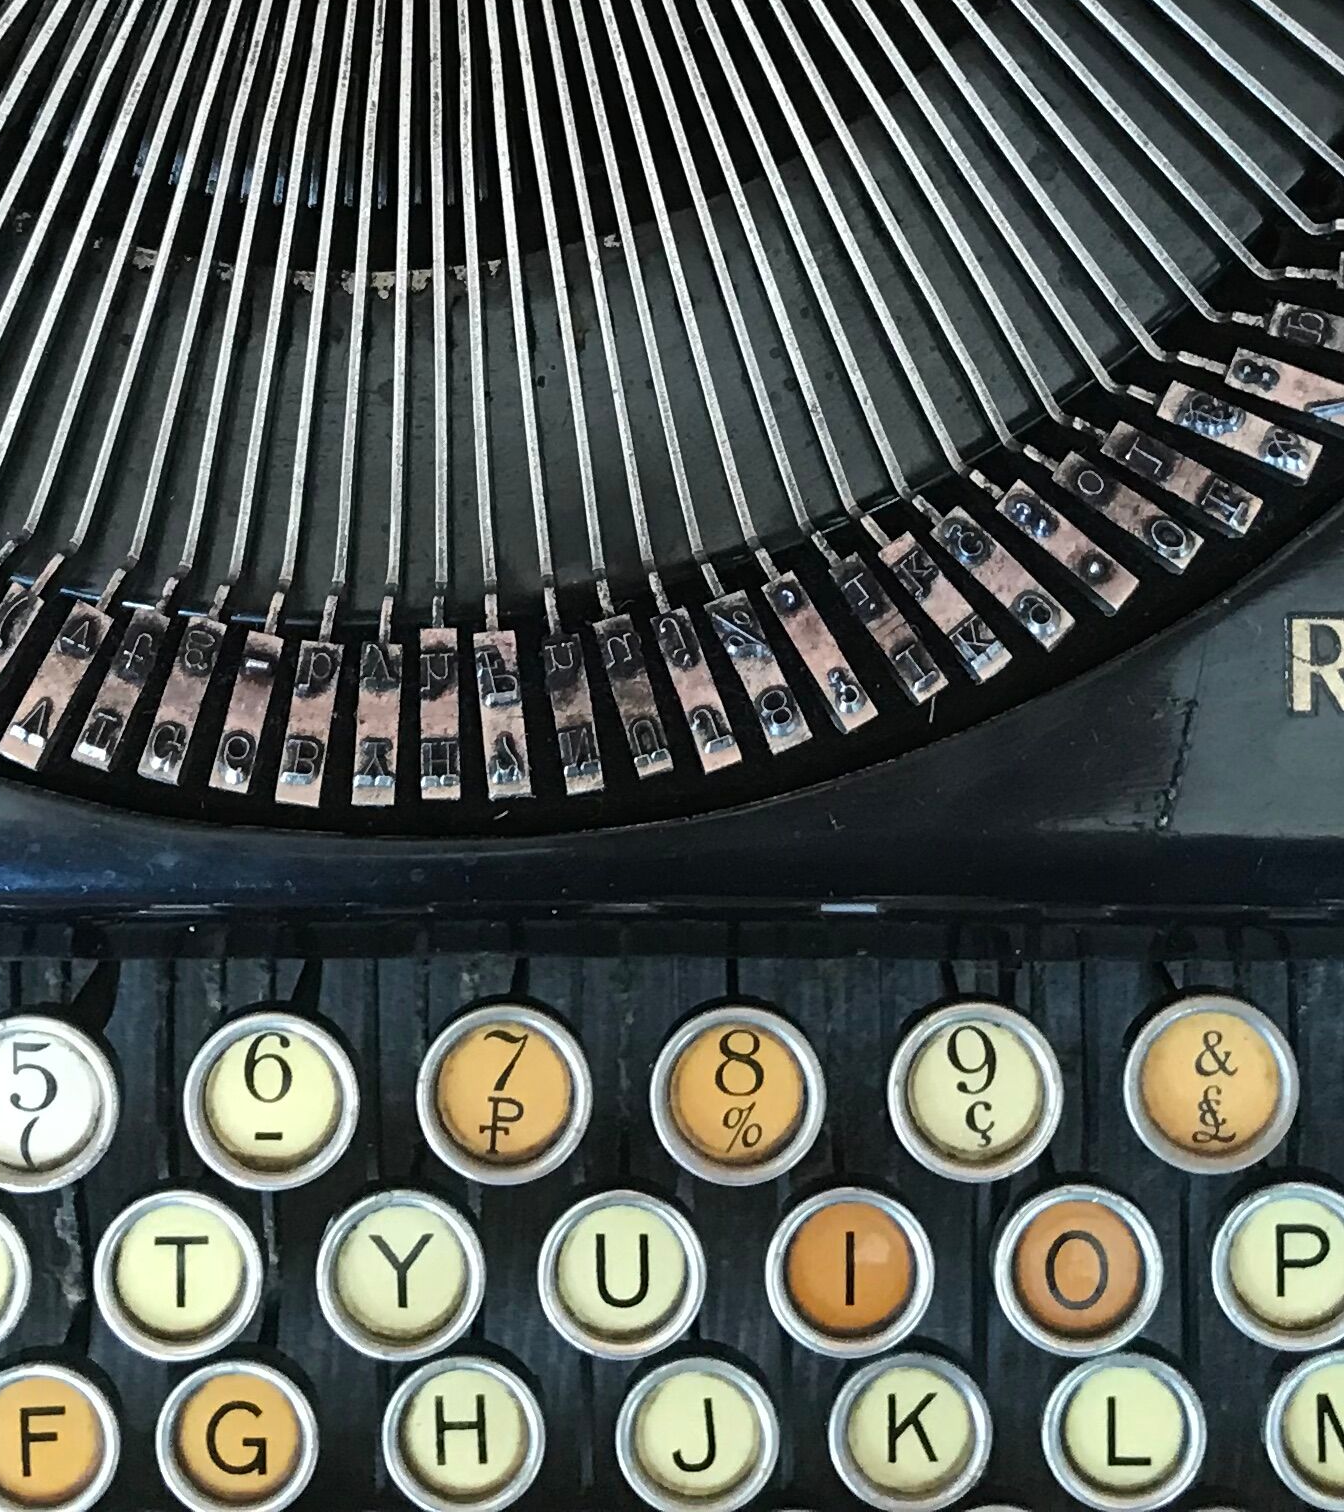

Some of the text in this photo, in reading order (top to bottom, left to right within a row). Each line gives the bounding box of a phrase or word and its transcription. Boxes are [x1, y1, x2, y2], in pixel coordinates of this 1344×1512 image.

[9, 1041, 59, 1112] 5
[243, 1032, 293, 1104] 6
[484, 1029, 530, 1092] 7
[714, 1028, 764, 1097] 8
[946, 1024, 998, 1095] 9
[1194, 1029, 1238, 1079] &
[19, 1116, 39, 1171] (
[722, 1101, 764, 1153] %
[965, 1100, 995, 1147] ç
[154, 1235, 209, 1308] T
[368, 1233, 435, 1309] Y
[595, 1233, 650, 1308] U
[845, 1230, 855, 1306] I
[1045, 1229, 1108, 1310] O
[1275, 1222, 1331, 1297] P
[18, 1405, 66, 1477] F
[206, 1399, 269, 1477] G
[435, 1393, 488, 1466] H
[672, 1397, 717, 1473] J
[888, 1392, 938, 1463] K
[1107, 1395, 1152, 1467] L
